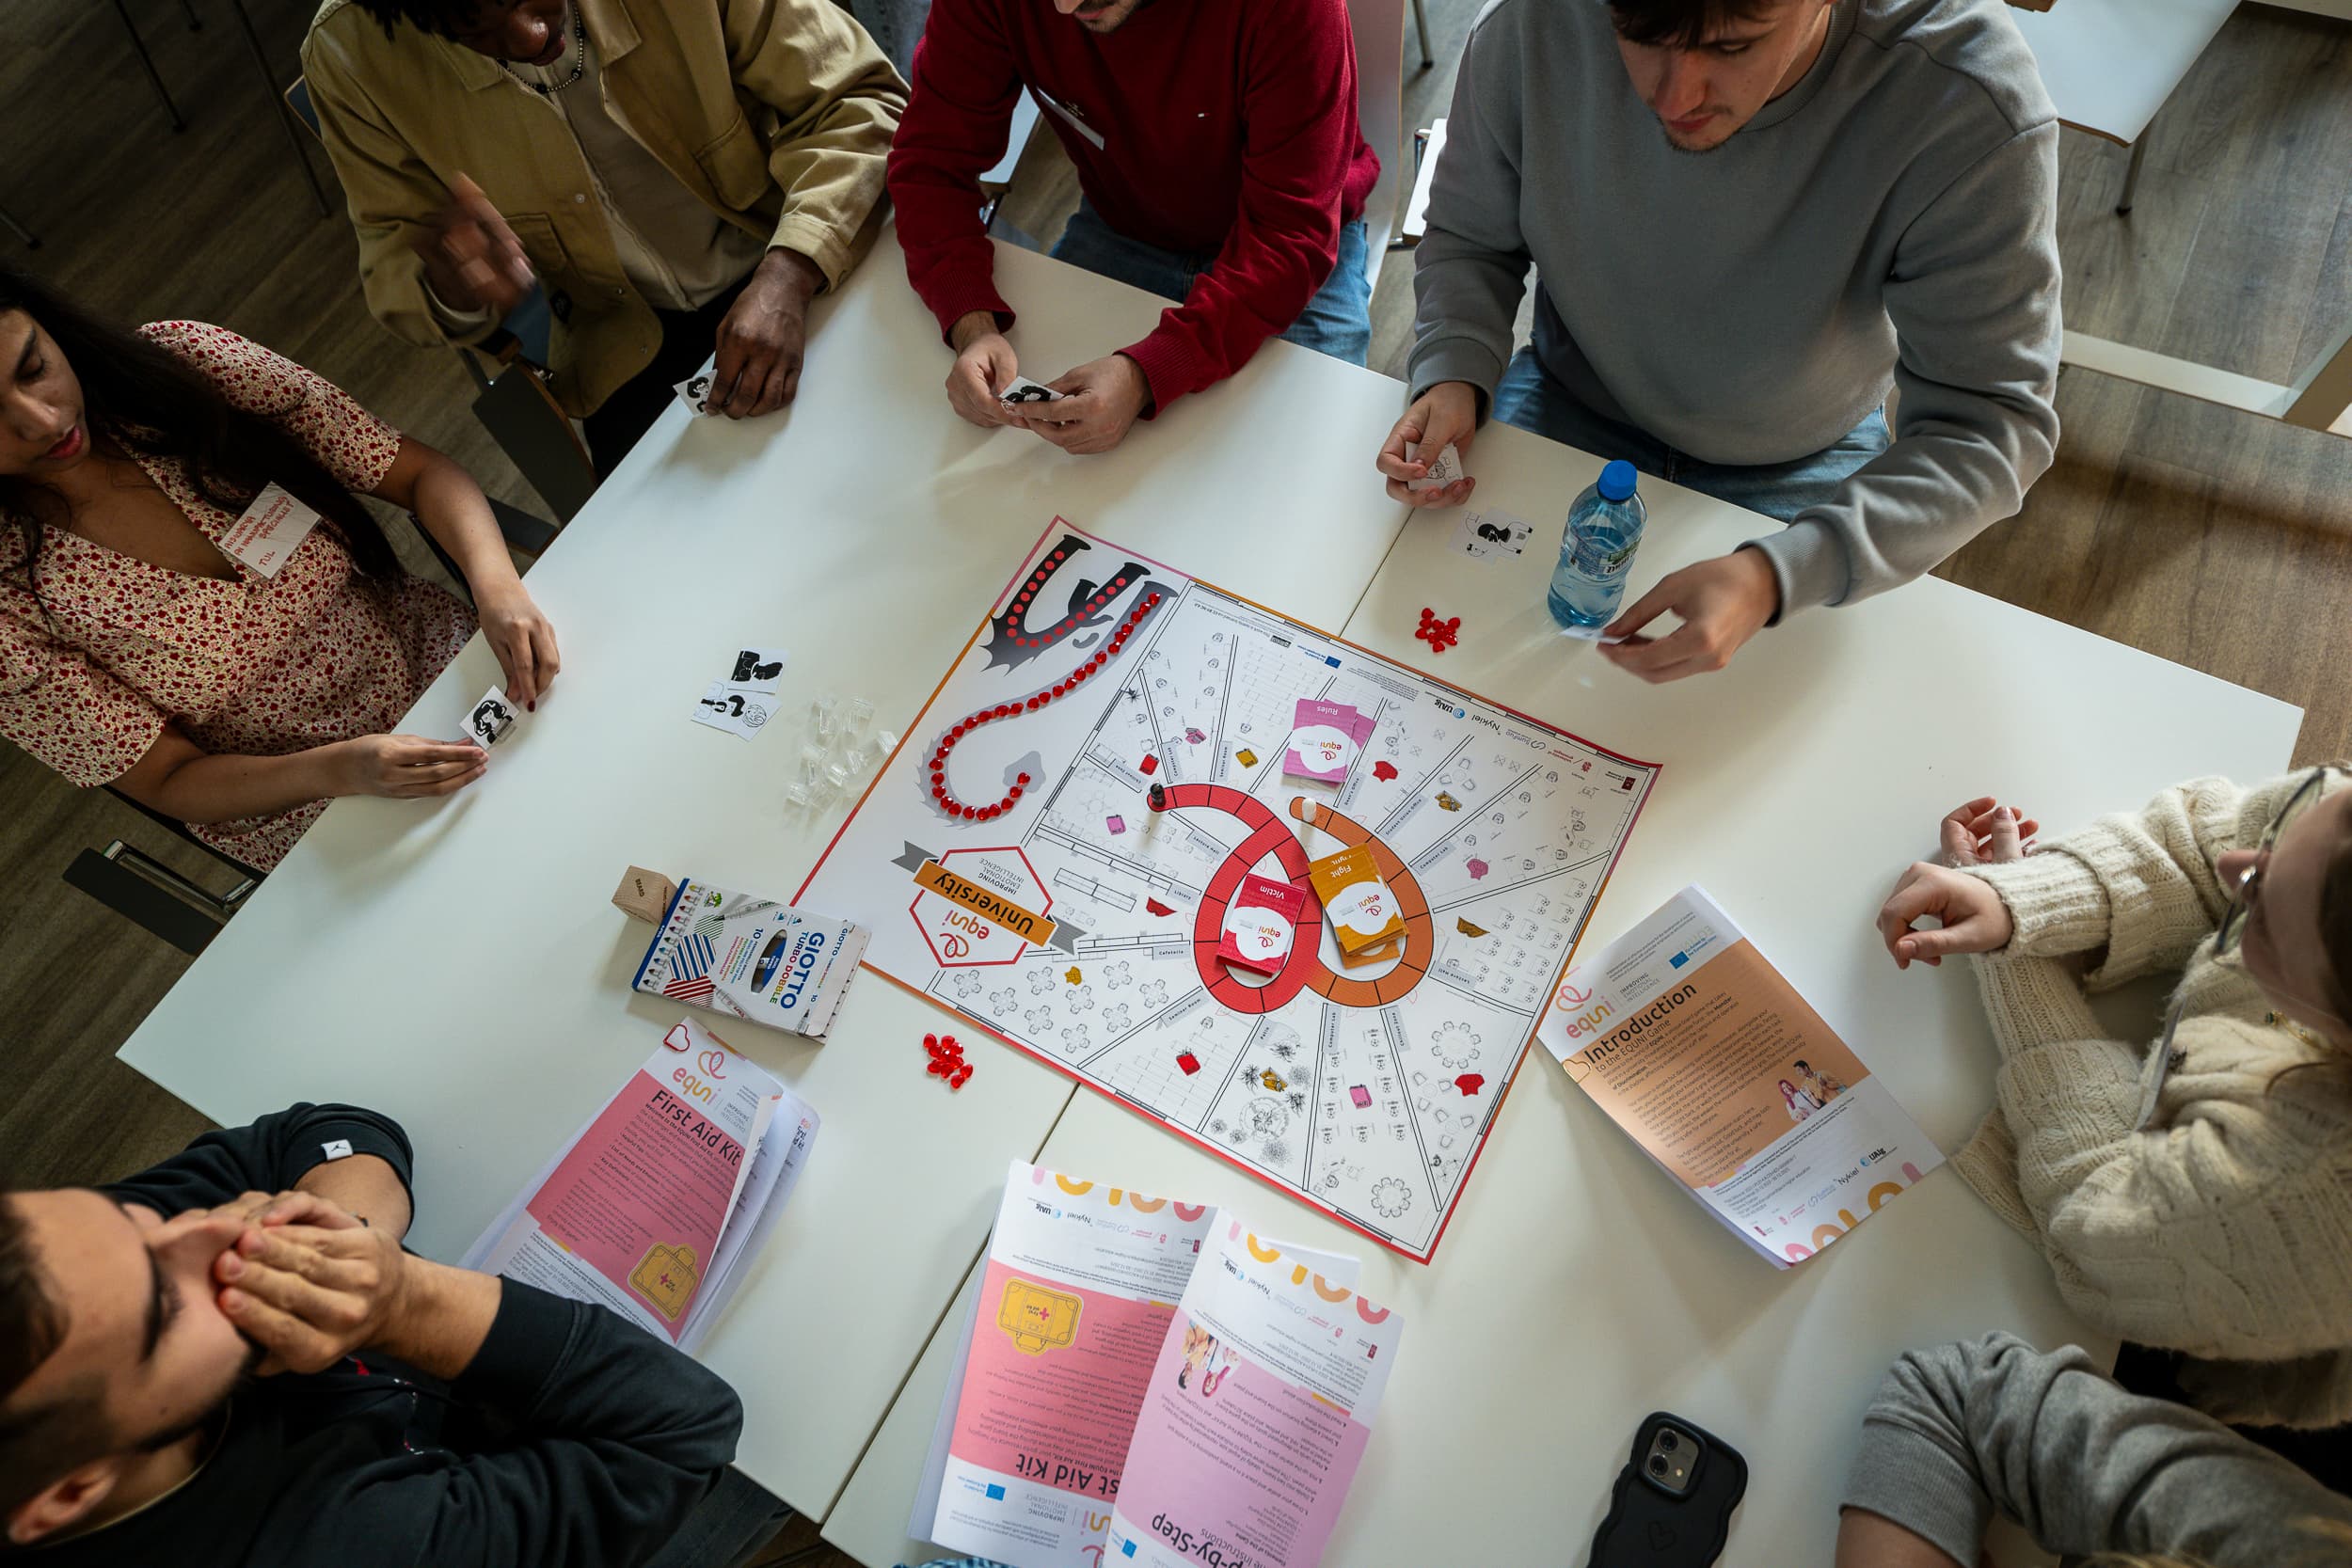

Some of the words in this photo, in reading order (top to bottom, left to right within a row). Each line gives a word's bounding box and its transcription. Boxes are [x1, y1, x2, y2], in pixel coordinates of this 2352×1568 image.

[257, 547, 276, 567] TUL
[1317, 706, 1338, 715] Rules
[1433, 698, 1454, 713] UAlg
[1470, 711, 1501, 731] Nykiel
[977, 856, 1025, 883] INTELLIGENCE
[980, 865, 1021, 889] EMOTIONAL
[1331, 864, 1352, 879] Fight
[977, 871, 1017, 895] IMPROVING
[1260, 885, 1284, 899] Victim
[930, 869, 1038, 935] University
[1359, 895, 1380, 909] equni
[752, 926, 764, 940] 10
[941, 904, 993, 944] equni
[1258, 925, 1280, 938] equni
[788, 928, 809, 964] TURBO
[831, 927, 848, 957] GIOTTO
[778, 928, 827, 1013] GIOTTO
[769, 963, 793, 1006] DOBBLE
[809, 992, 818, 1003] 10
[1561, 993, 1620, 1046] equni
[1582, 978, 1698, 1065] Introduction
[1595, 1062, 1607, 1073] to
[1604, 1051, 1621, 1067] the
[1619, 1033, 1648, 1057] EQUNI
[1645, 1017, 1671, 1038] Game
[666, 1060, 722, 1111] equni
[649, 1086, 695, 1127] First
[689, 1117, 723, 1148] Aid
[717, 1139, 744, 1165] Kit
[1836, 1166, 1861, 1187] Nykiel
[1034, 1203, 1051, 1214] UAlg
[1066, 1210, 1091, 1224] Nykiel
[1246, 1275, 1272, 1295] Nykiel
[1013, 1452, 1049, 1480] Kit
[1053, 1464, 1093, 1492] Aid
[1026, 1507, 1065, 1522] IMPROVING
[1079, 1509, 1112, 1541] uni
[1196, 1527, 1255, 1566] Instructions
